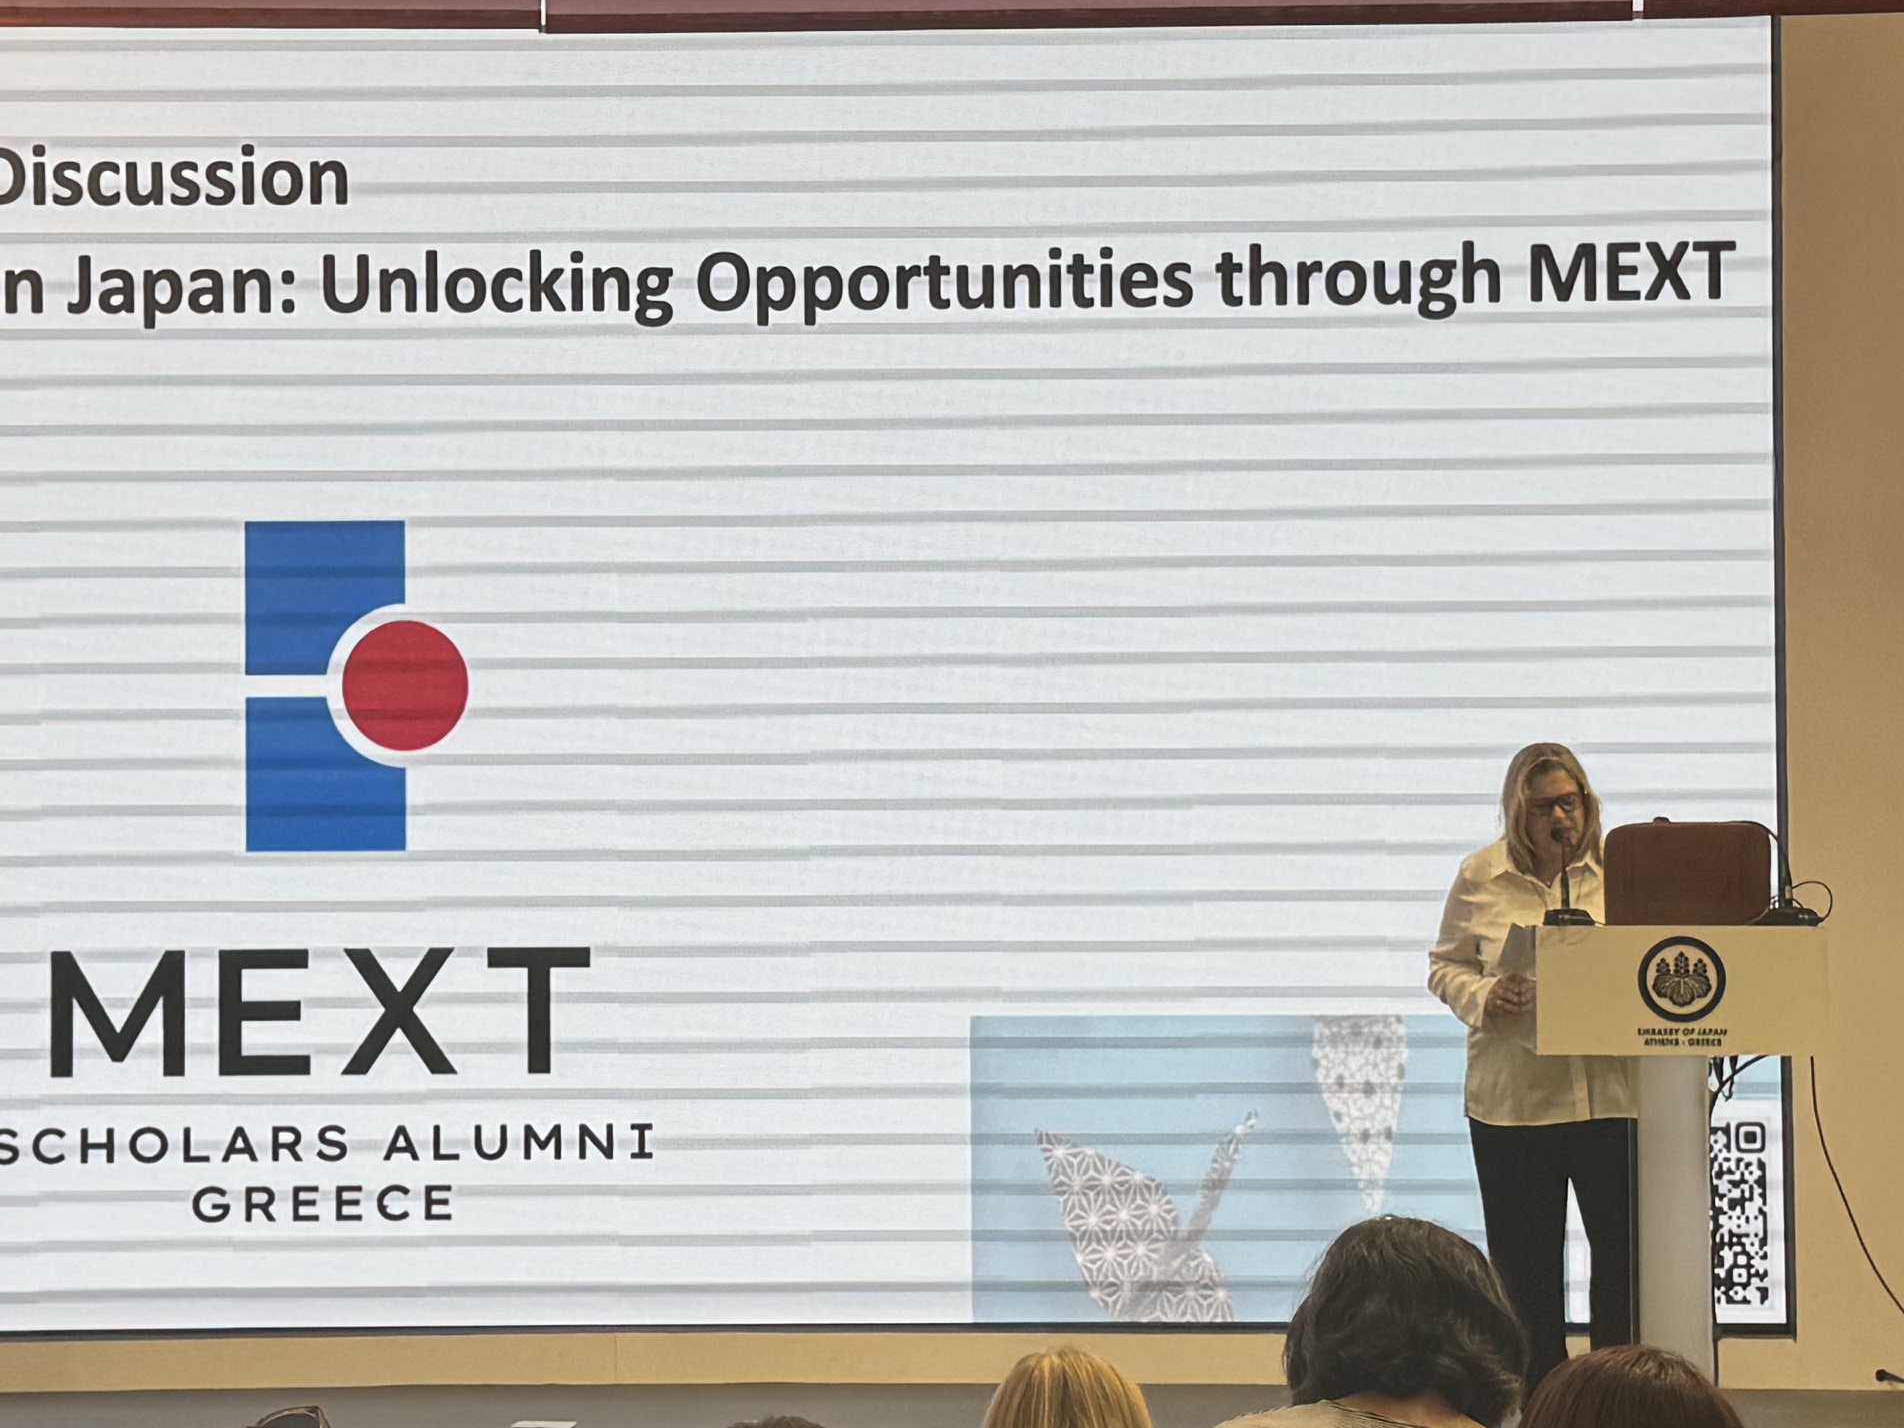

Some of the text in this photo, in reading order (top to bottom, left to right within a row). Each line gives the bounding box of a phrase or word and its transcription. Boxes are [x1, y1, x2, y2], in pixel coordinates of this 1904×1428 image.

[66, 253, 298, 329] Japan:
[322, 248, 674, 328] Unlocking
[697, 246, 1194, 326] Opportunities
[1214, 241, 1502, 320] through
[1528, 239, 1737, 303] MEXT
[50, 946, 591, 1079] MEXT
[382, 1122, 654, 1162] ALUMNI
[191, 1184, 453, 1224] GREECE
